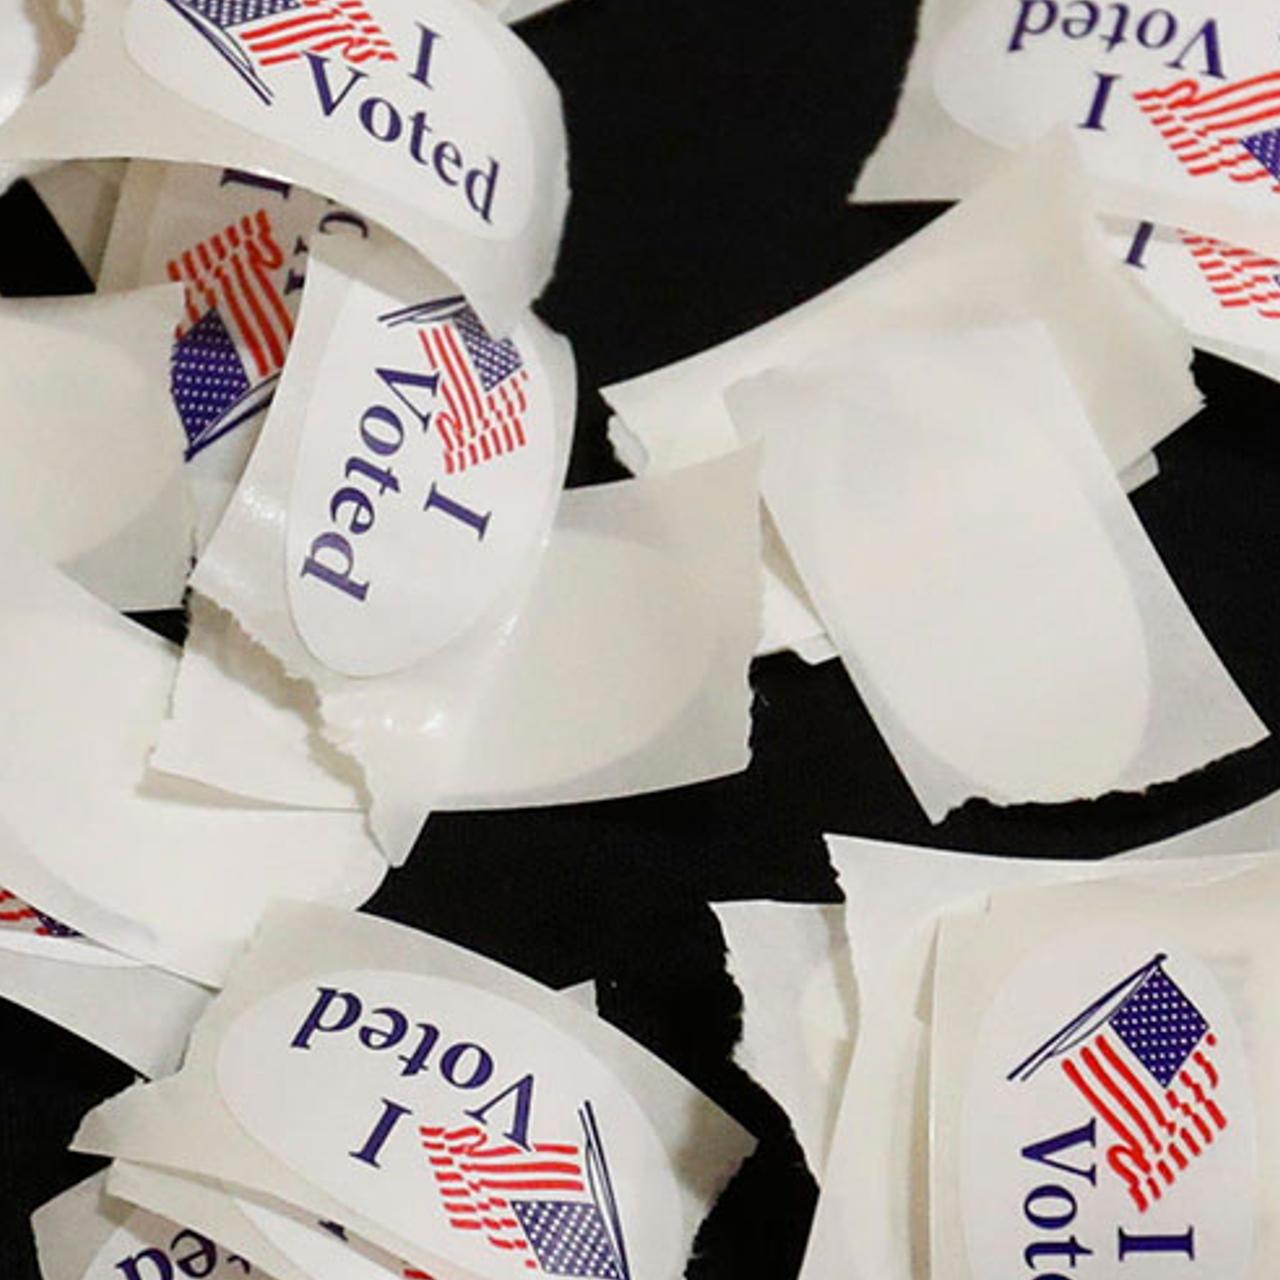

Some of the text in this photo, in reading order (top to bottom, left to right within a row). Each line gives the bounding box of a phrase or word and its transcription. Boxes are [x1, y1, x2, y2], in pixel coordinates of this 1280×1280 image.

[408, 20, 444, 90] I
[1077, 70, 1123, 131] I
[302, 50, 502, 225] Voted
[300, 364, 444, 605] Voted
[422, 482, 493, 542] I
[289, 985, 538, 1153] Voted
[348, 1096, 414, 1170] I
[1117, 1224, 1198, 1263] I
